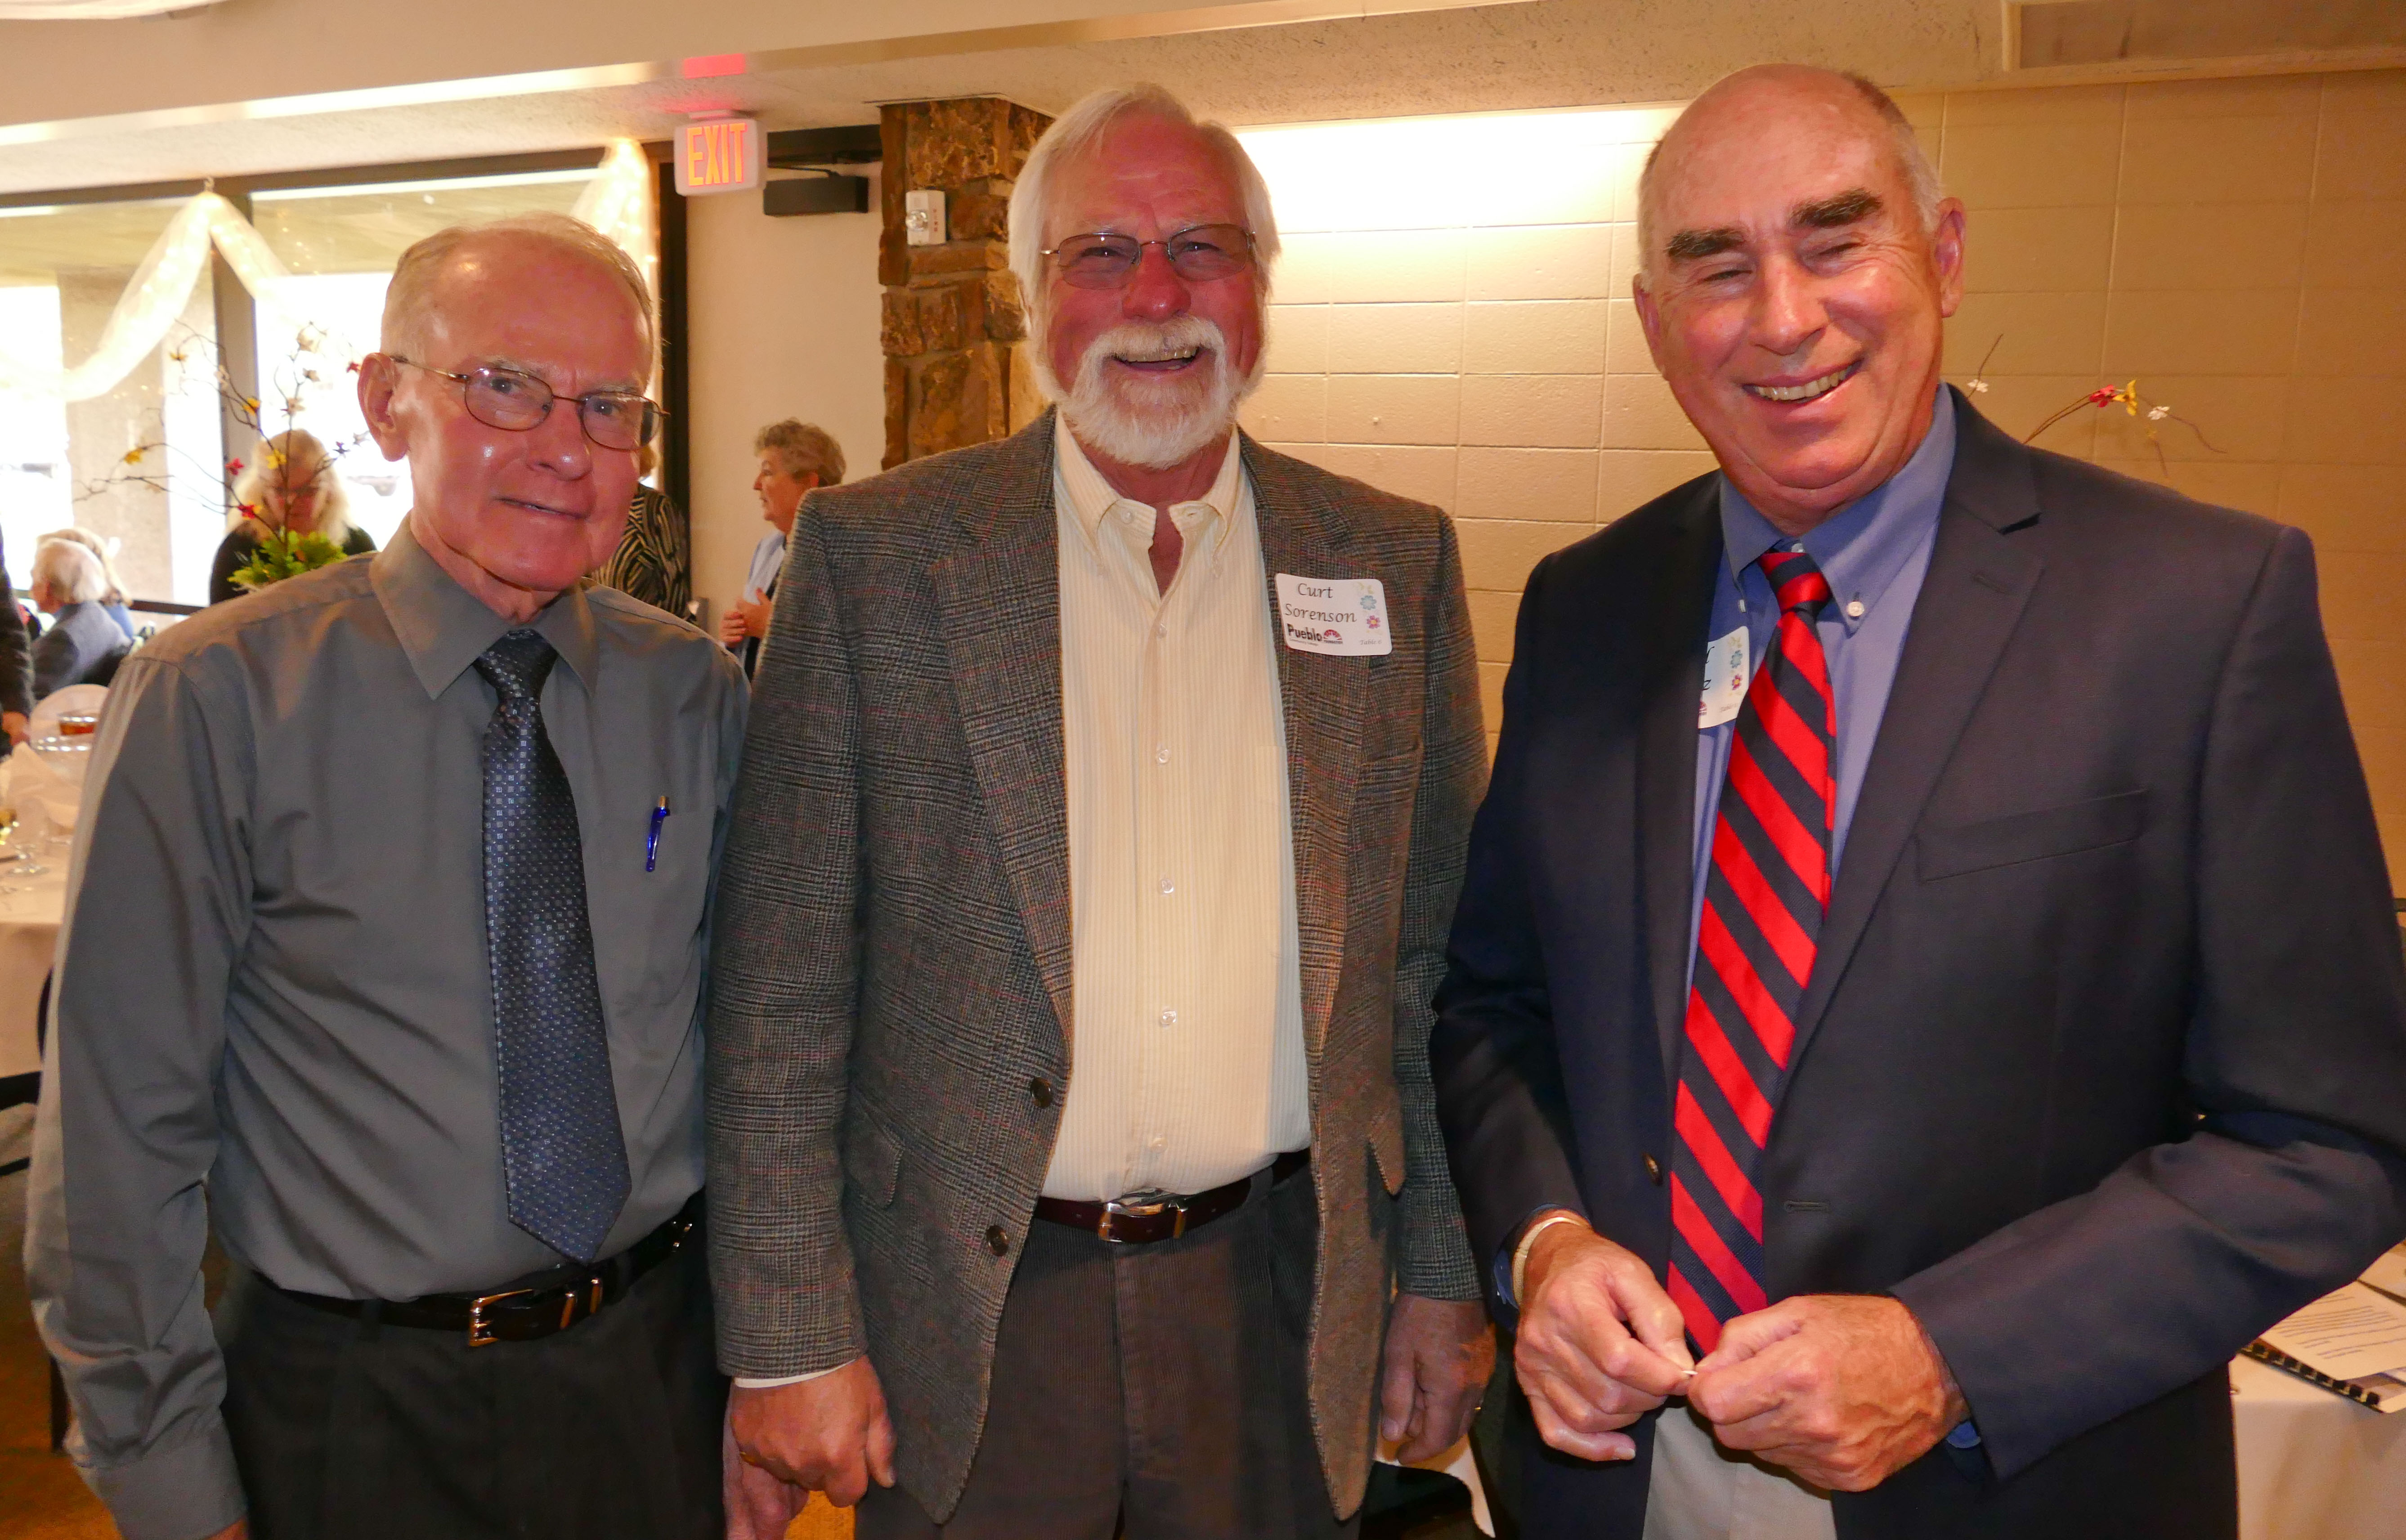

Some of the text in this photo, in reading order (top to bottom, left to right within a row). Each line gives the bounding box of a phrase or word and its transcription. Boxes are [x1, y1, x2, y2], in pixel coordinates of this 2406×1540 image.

[686, 122, 747, 186] EXIT
[1298, 583, 1333, 598] Curt
[1285, 604, 1357, 622] Sorenson
[1287, 623, 1322, 641] Pueblo
